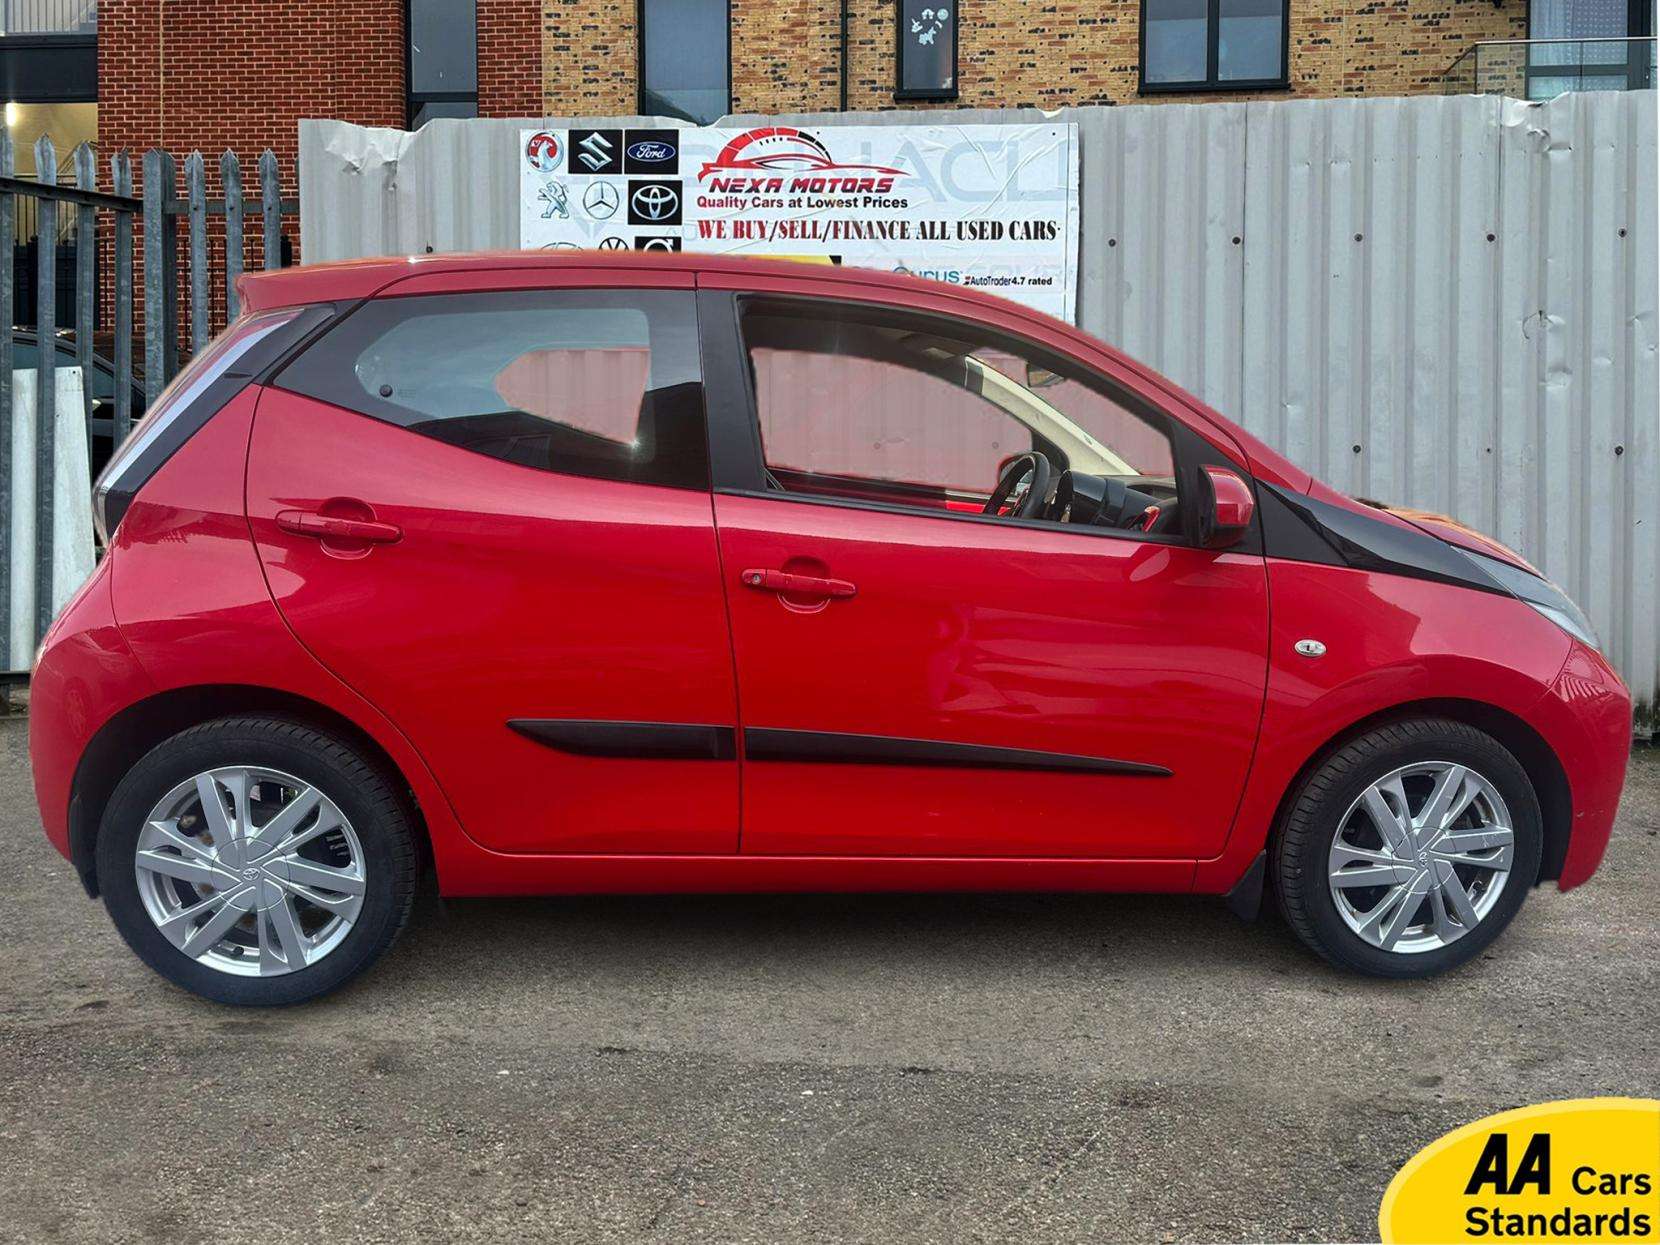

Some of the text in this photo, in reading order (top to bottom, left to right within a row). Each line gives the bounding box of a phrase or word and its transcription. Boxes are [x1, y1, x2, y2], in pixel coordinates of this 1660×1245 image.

[636, 144, 666, 158] Ford
[709, 178, 895, 193] NEXA MOTORS
[697, 196, 908, 210] Quality Cars at Lowest Prices
[697, 220, 727, 239] WE
[916, 220, 950, 240] ALL
[956, 220, 1004, 240] USED
[1009, 220, 1057, 240] CARS
[1028, 276, 1053, 285] rated
